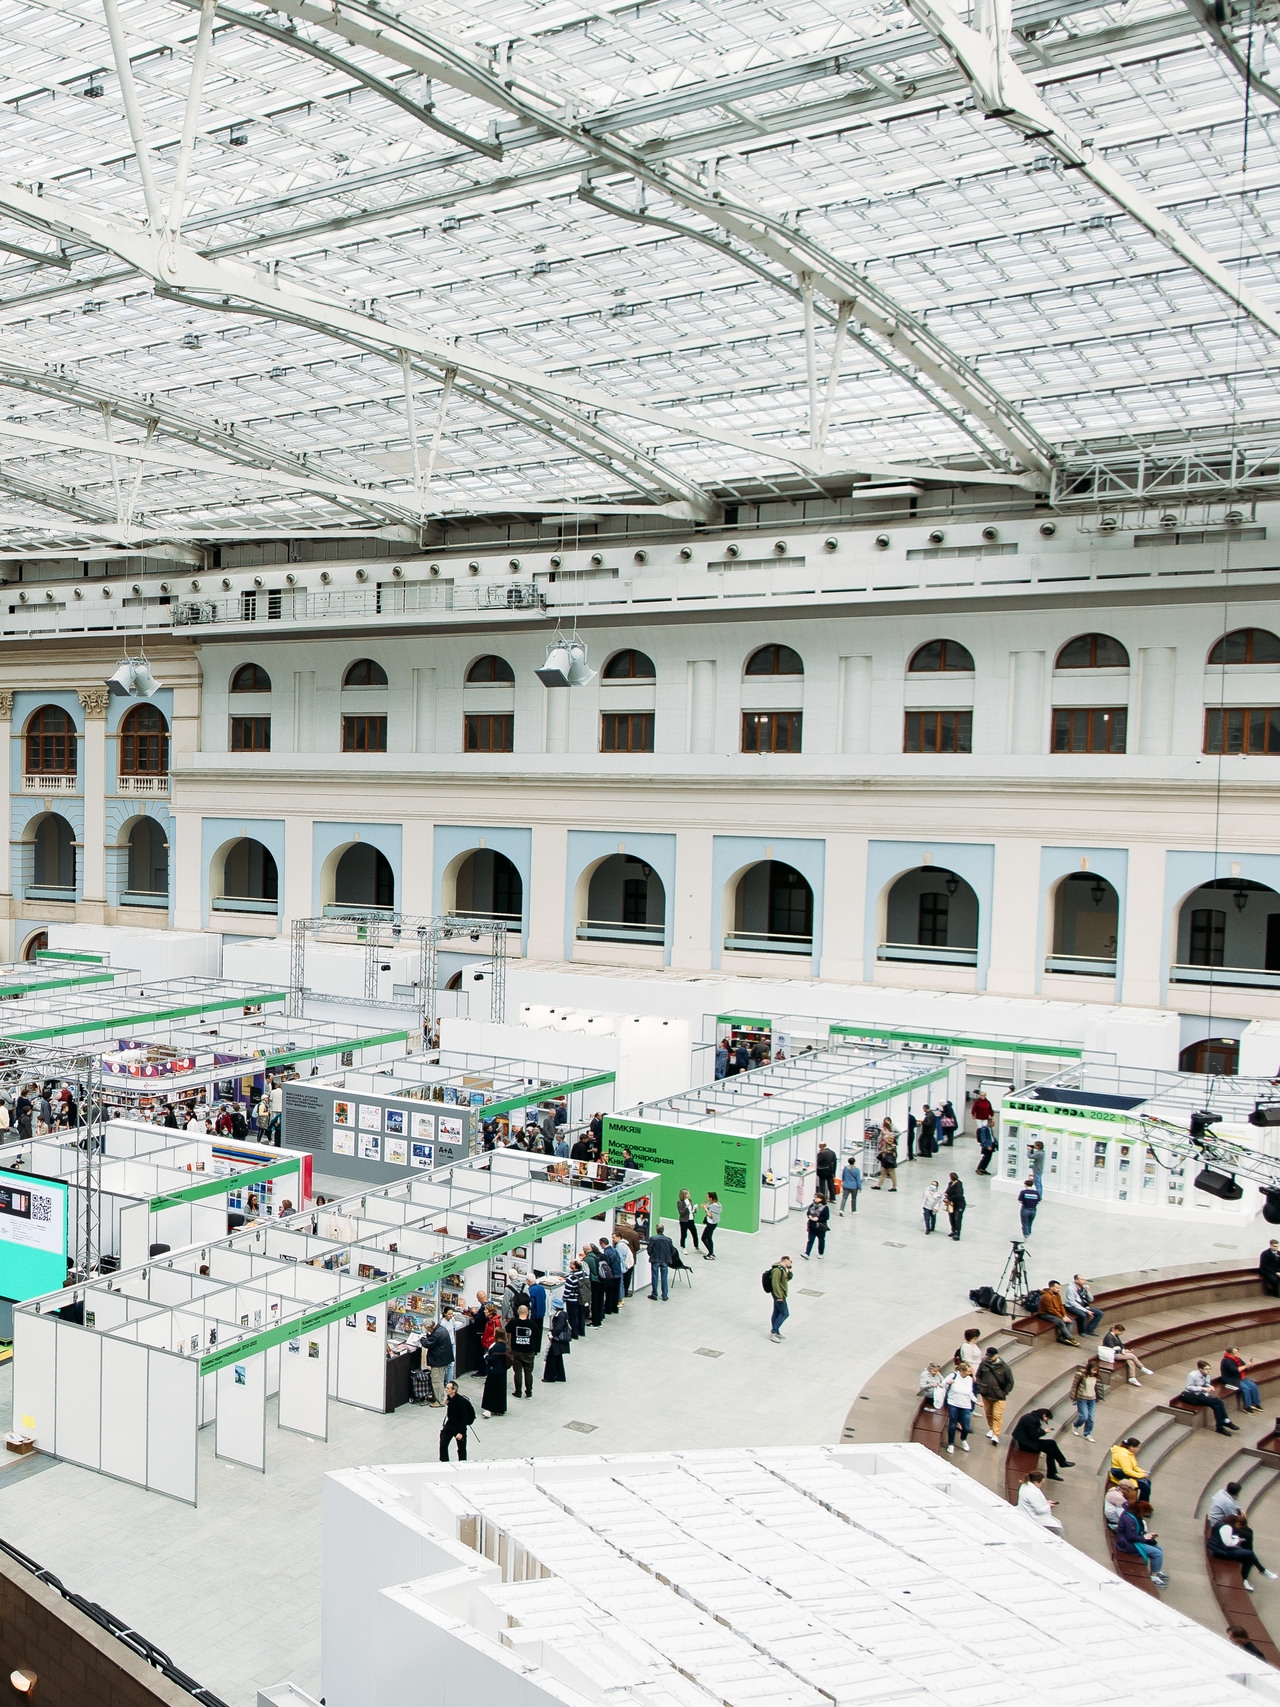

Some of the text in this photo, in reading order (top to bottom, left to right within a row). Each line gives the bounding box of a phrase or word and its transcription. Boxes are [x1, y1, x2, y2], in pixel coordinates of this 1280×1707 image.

[1054, 1107, 1086, 1118] ГОДА
[1090, 1111, 1116, 1121] 2022
[608, 1122, 635, 1134] ММКЯ
[608, 1139, 657, 1154] Московская
[608, 1148, 674, 1165] Меународная
[608, 1157, 644, 1169] Книая
